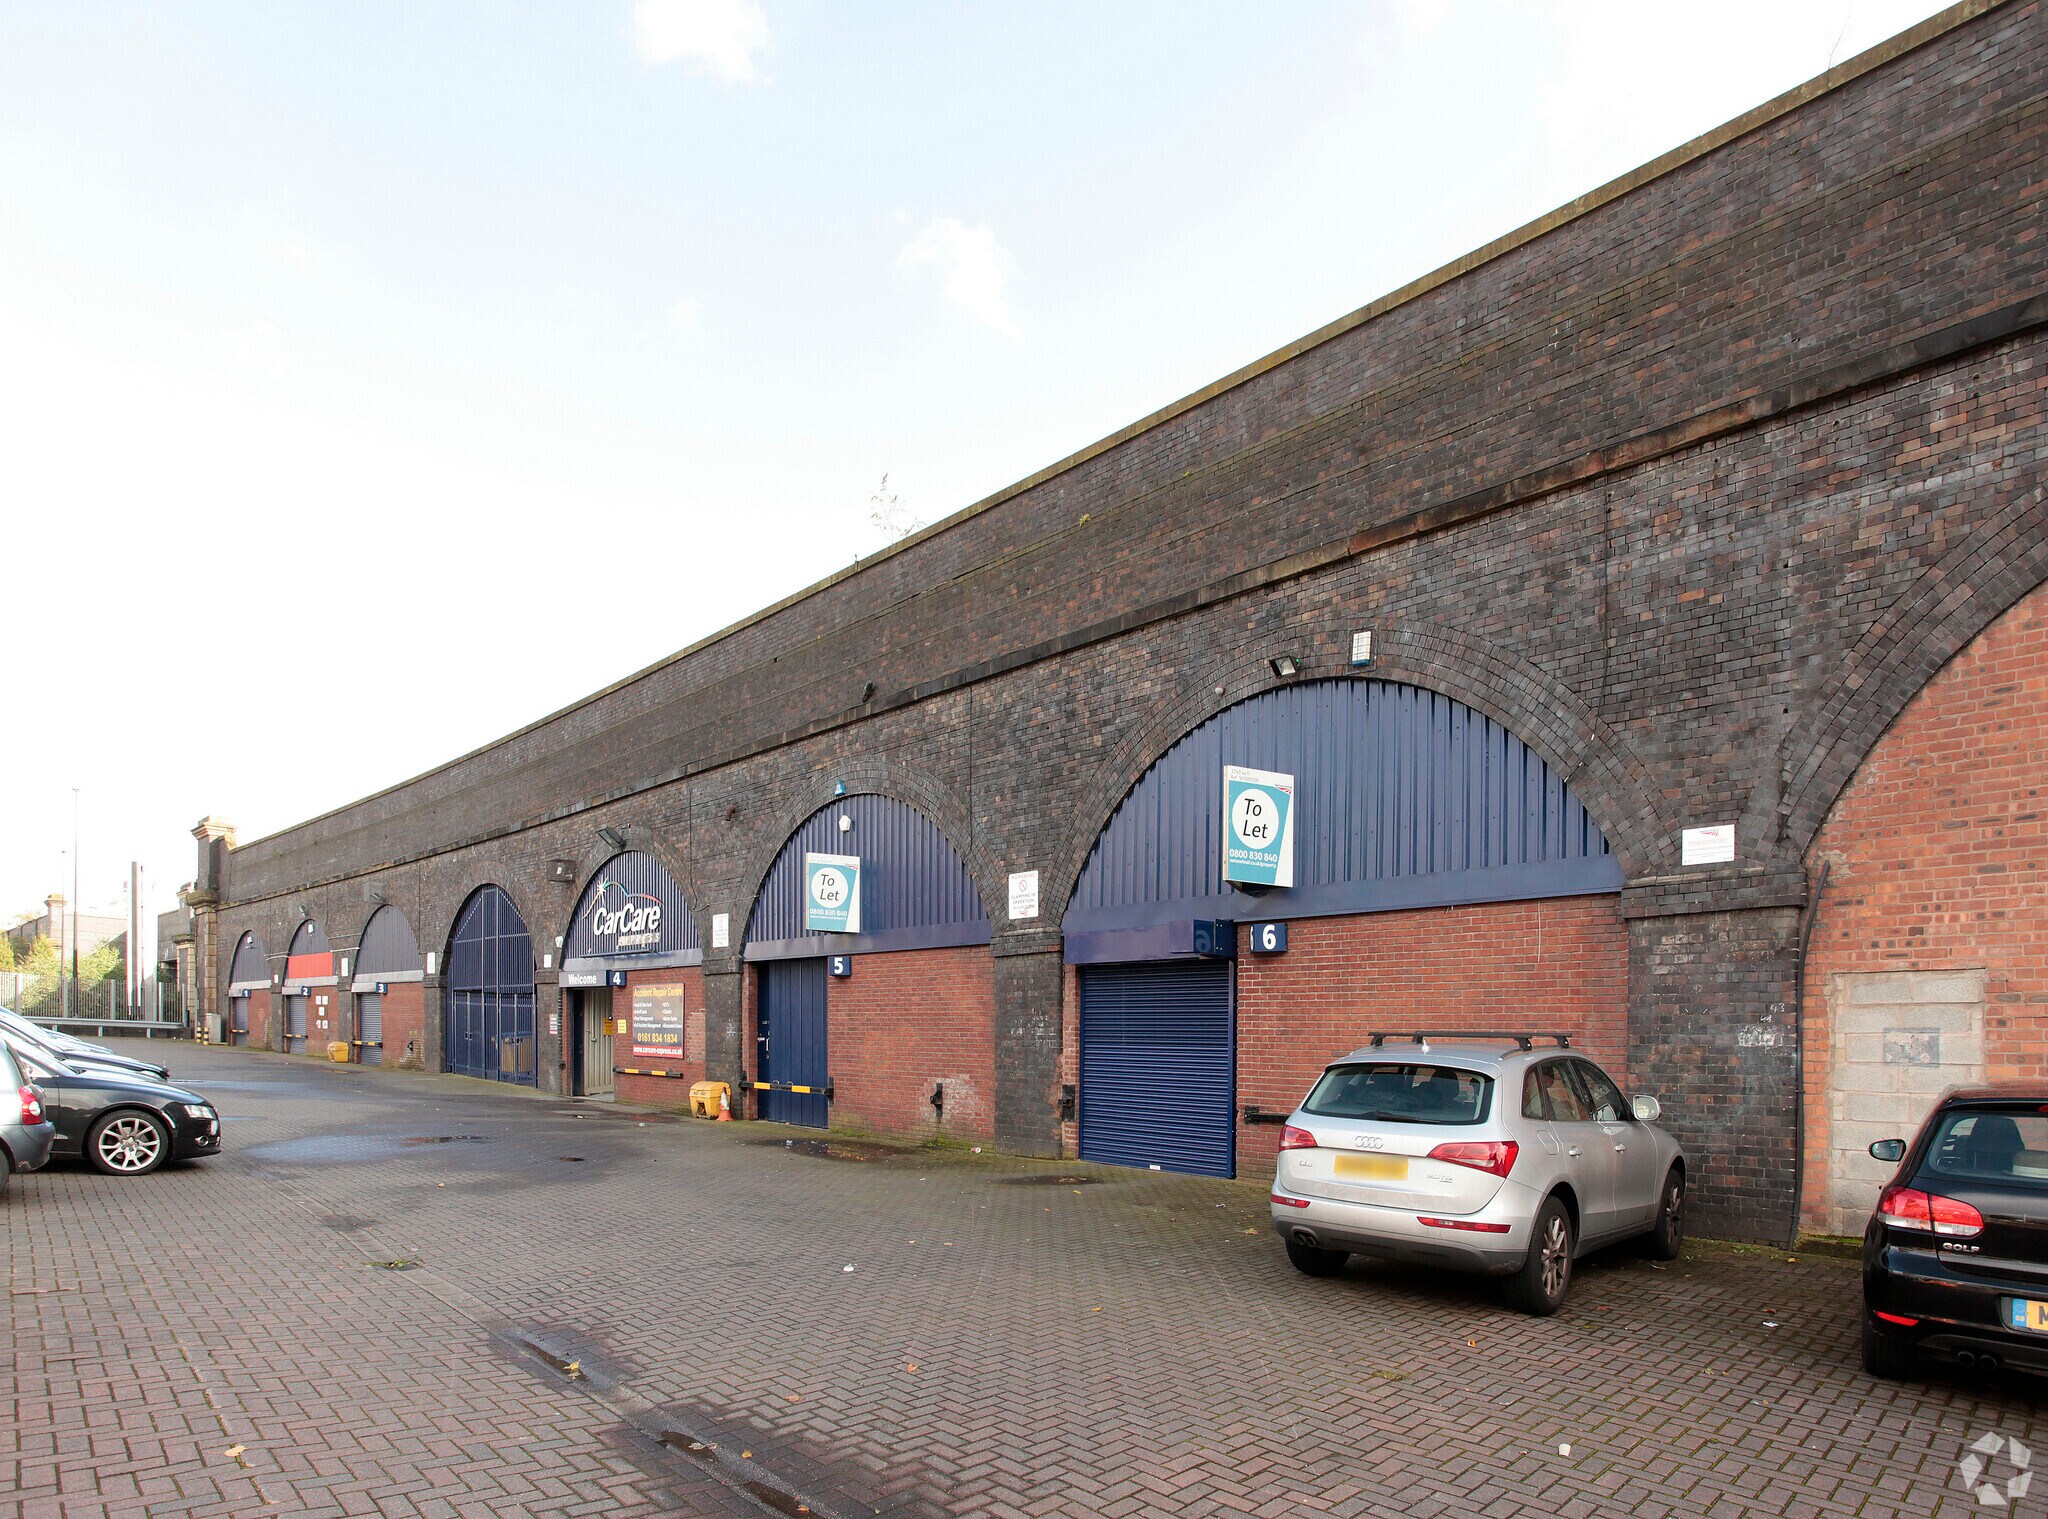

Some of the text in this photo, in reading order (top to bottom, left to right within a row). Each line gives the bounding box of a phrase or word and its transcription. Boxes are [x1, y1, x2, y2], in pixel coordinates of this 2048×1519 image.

[1244, 798, 1262, 816] To
[1243, 820, 1268, 838] Let
[1230, 848, 1278, 862] 0800 830 840
[821, 874, 834, 886] To
[820, 889, 840, 901] Let
[594, 903, 660, 936] CarCare
[1262, 924, 1276, 950] 6
[834, 957, 844, 974] 5
[568, 974, 597, 985] Welcome
[612, 972, 621, 985] 4
[378, 984, 384, 992] 3
[634, 987, 683, 998] Accident Repair Centre
[638, 1033, 678, 1043] 0161 834 1834
[1942, 1242, 1980, 1252] GOLF
